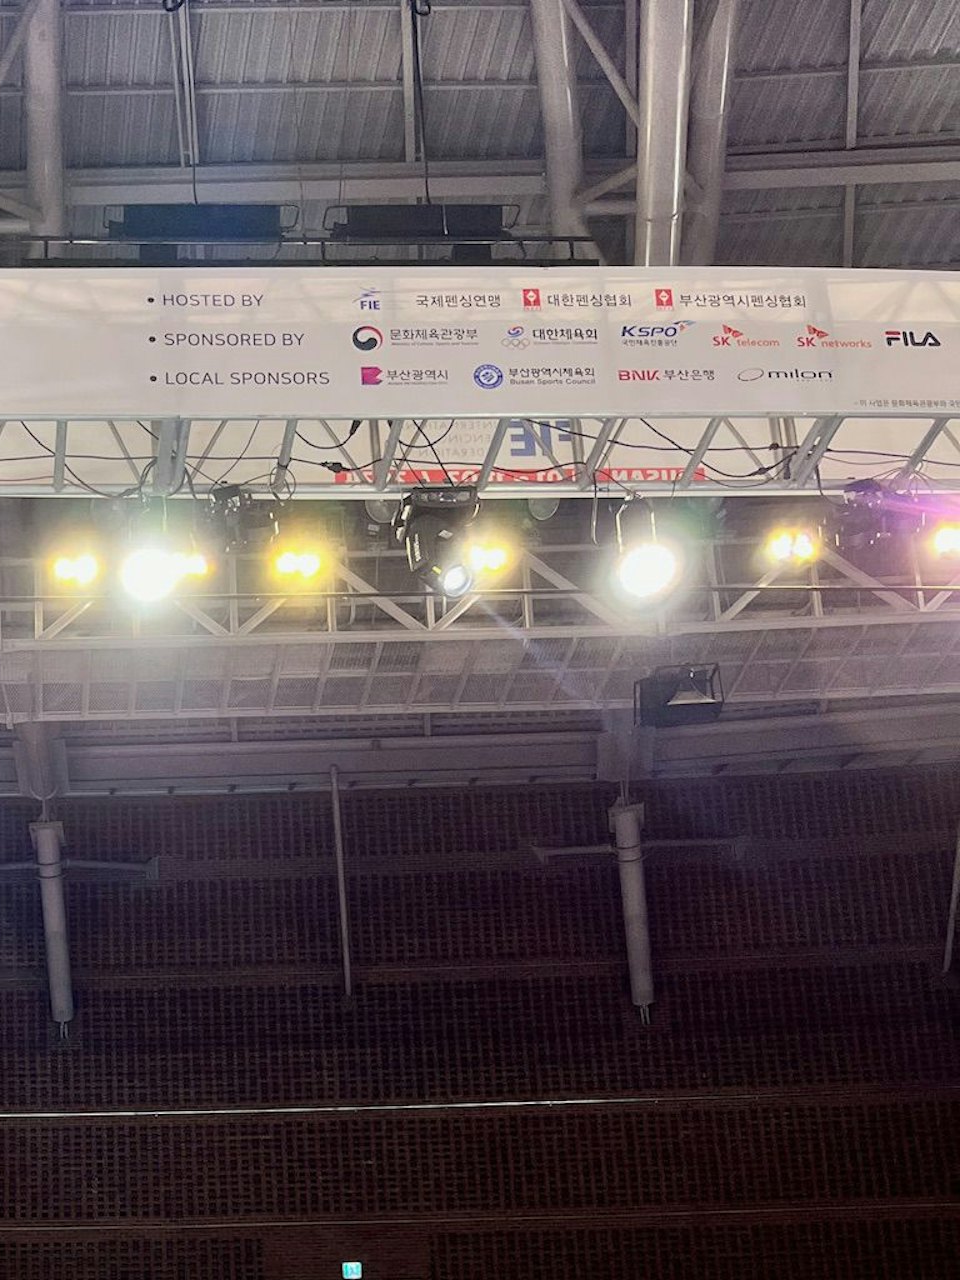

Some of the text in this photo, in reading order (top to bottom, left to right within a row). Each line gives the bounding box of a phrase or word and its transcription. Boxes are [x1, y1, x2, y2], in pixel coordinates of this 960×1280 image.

[162, 294, 264, 307] HOSTED BY
[360, 300, 381, 310] FIE
[416, 294, 501, 308] 국제펜싱연맹
[547, 294, 632, 307] 대한펜싱협회
[679, 294, 807, 308] 부산광역시펜싱협회
[390, 328, 478, 340] 문화체육관광부
[532, 328, 598, 341] 대한체육회
[621, 325, 677, 337] KSPO
[164, 333, 305, 346] SPONSORED BY
[713, 335, 780, 347] SK telecom
[797, 336, 872, 348] SK networks
[885, 330, 941, 347] FILA
[165, 371, 330, 385] LOCAL SPONSORS
[386, 369, 449, 381] 부산광역시
[618, 369, 715, 381] BNK 부산은행
[767, 368, 833, 379] milon
